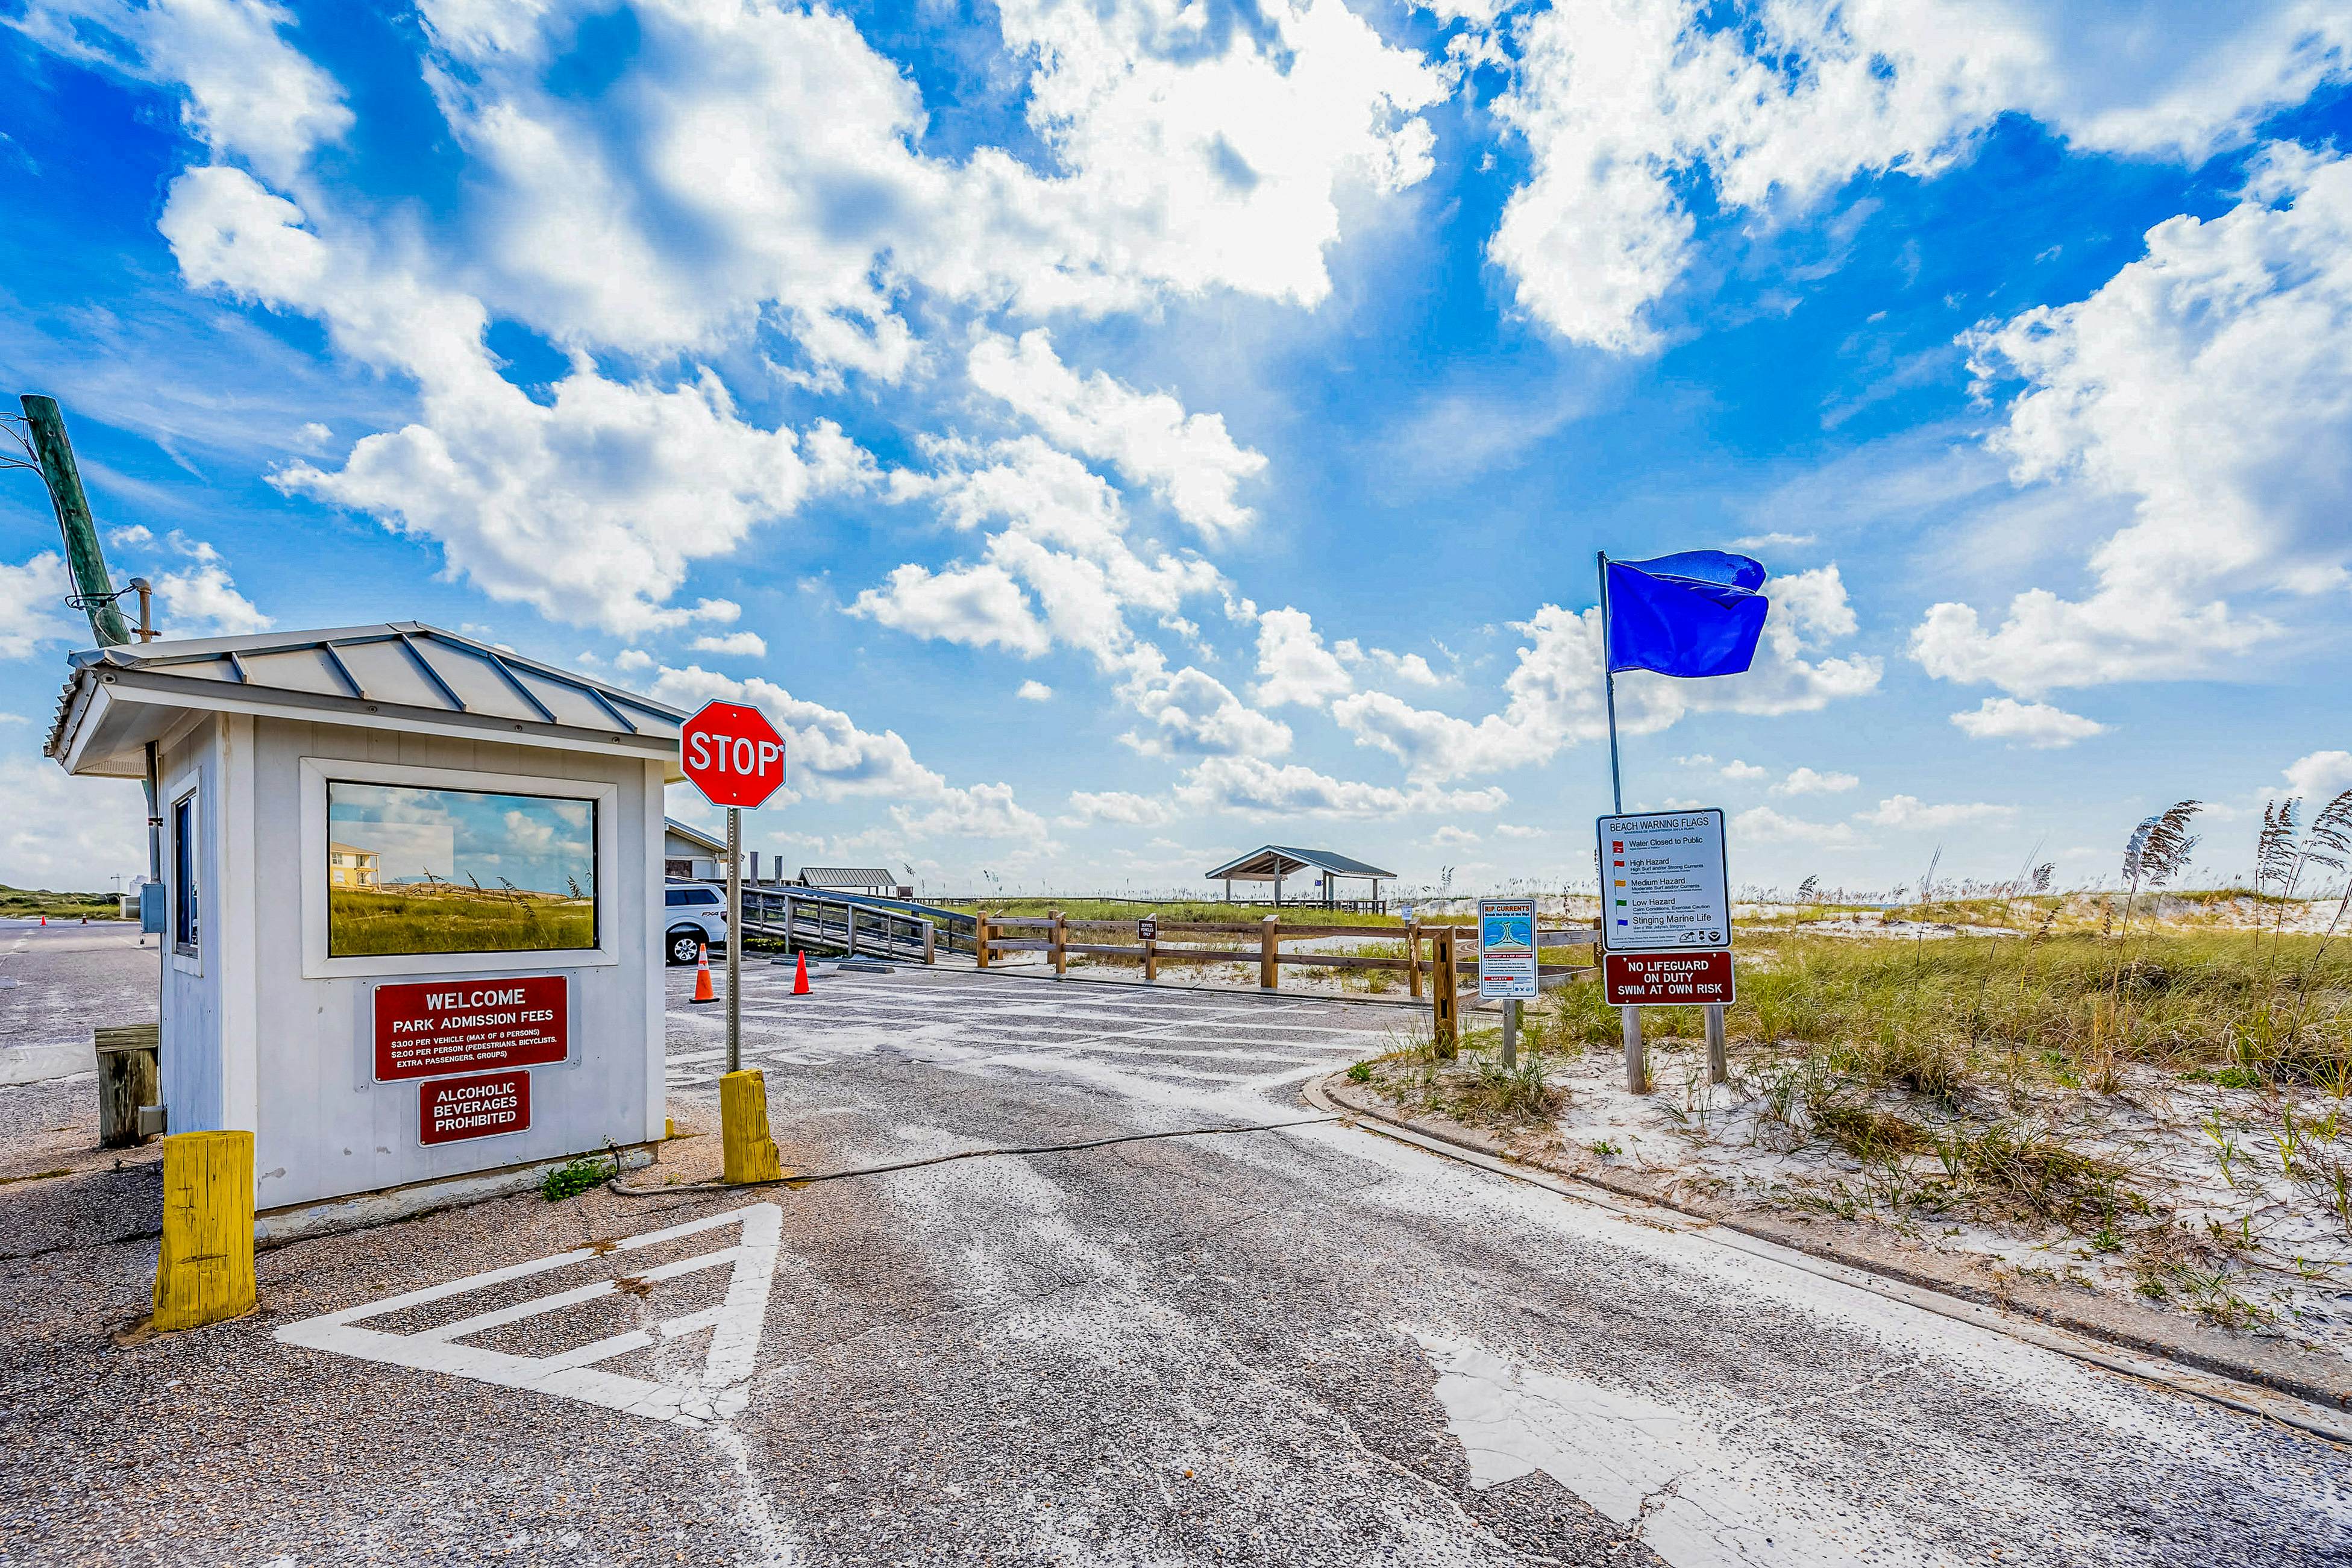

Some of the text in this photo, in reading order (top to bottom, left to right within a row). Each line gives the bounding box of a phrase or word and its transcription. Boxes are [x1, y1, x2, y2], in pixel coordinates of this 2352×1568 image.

[689, 731, 779, 777] STOP
[1610, 817, 1709, 832] BEACH WARNING FLAGS
[1683, 836, 1703, 844] Public
[1630, 859, 1644, 868] High
[1632, 913, 1711, 926] Stinging Marine Life
[1628, 961, 1709, 971] NO LIFEGUARD
[1644, 972, 1693, 983] ON DUTY
[1618, 983, 1722, 995] SWIM AT OWN RISK
[426, 988, 526, 1011] WELCOME
[393, 1009, 553, 1033] PARK ADMISSION FEES
[391, 1040, 413, 1049] $3.00
[433, 1035, 464, 1044] VEHICLE
[466, 1034, 485, 1043] (MAX
[506, 1029, 540, 1038] PERSONS)
[391, 1050, 414, 1059] $2.00
[433, 1046, 463, 1054] PERSON
[397, 1059, 423, 1068] EXTRA
[477, 1050, 507, 1059] GROUPS)
[436, 1082, 515, 1103] ALCOHOLIC
[434, 1096, 518, 1118] BEVERAGES
[435, 1111, 516, 1132] PROHIBITED
